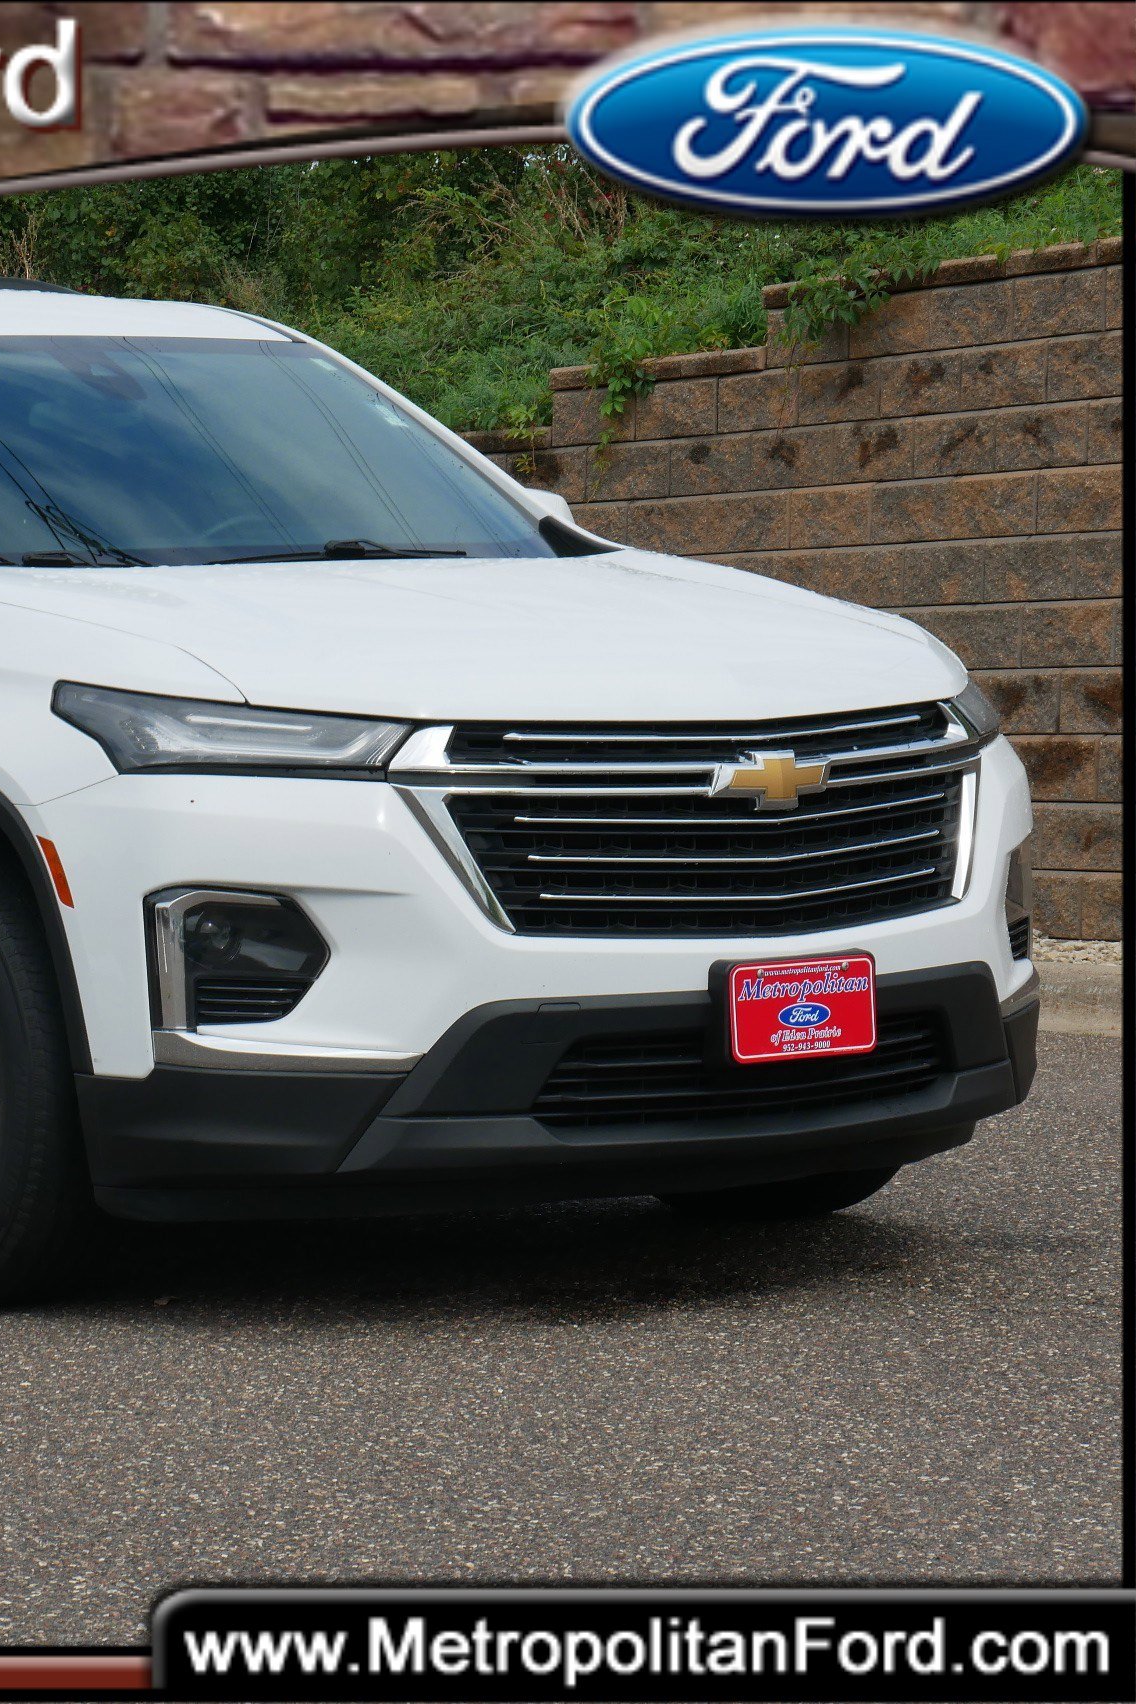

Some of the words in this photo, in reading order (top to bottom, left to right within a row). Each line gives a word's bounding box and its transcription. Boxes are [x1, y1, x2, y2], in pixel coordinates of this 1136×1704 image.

[737, 971, 869, 1003] Metropolitan
[789, 1006, 820, 1023] Ford
[770, 1030, 782, 1046] of
[782, 1028, 807, 1042] Eden
[807, 1025, 842, 1040] Prairie
[782, 1040, 831, 1053] 952-943-9000
